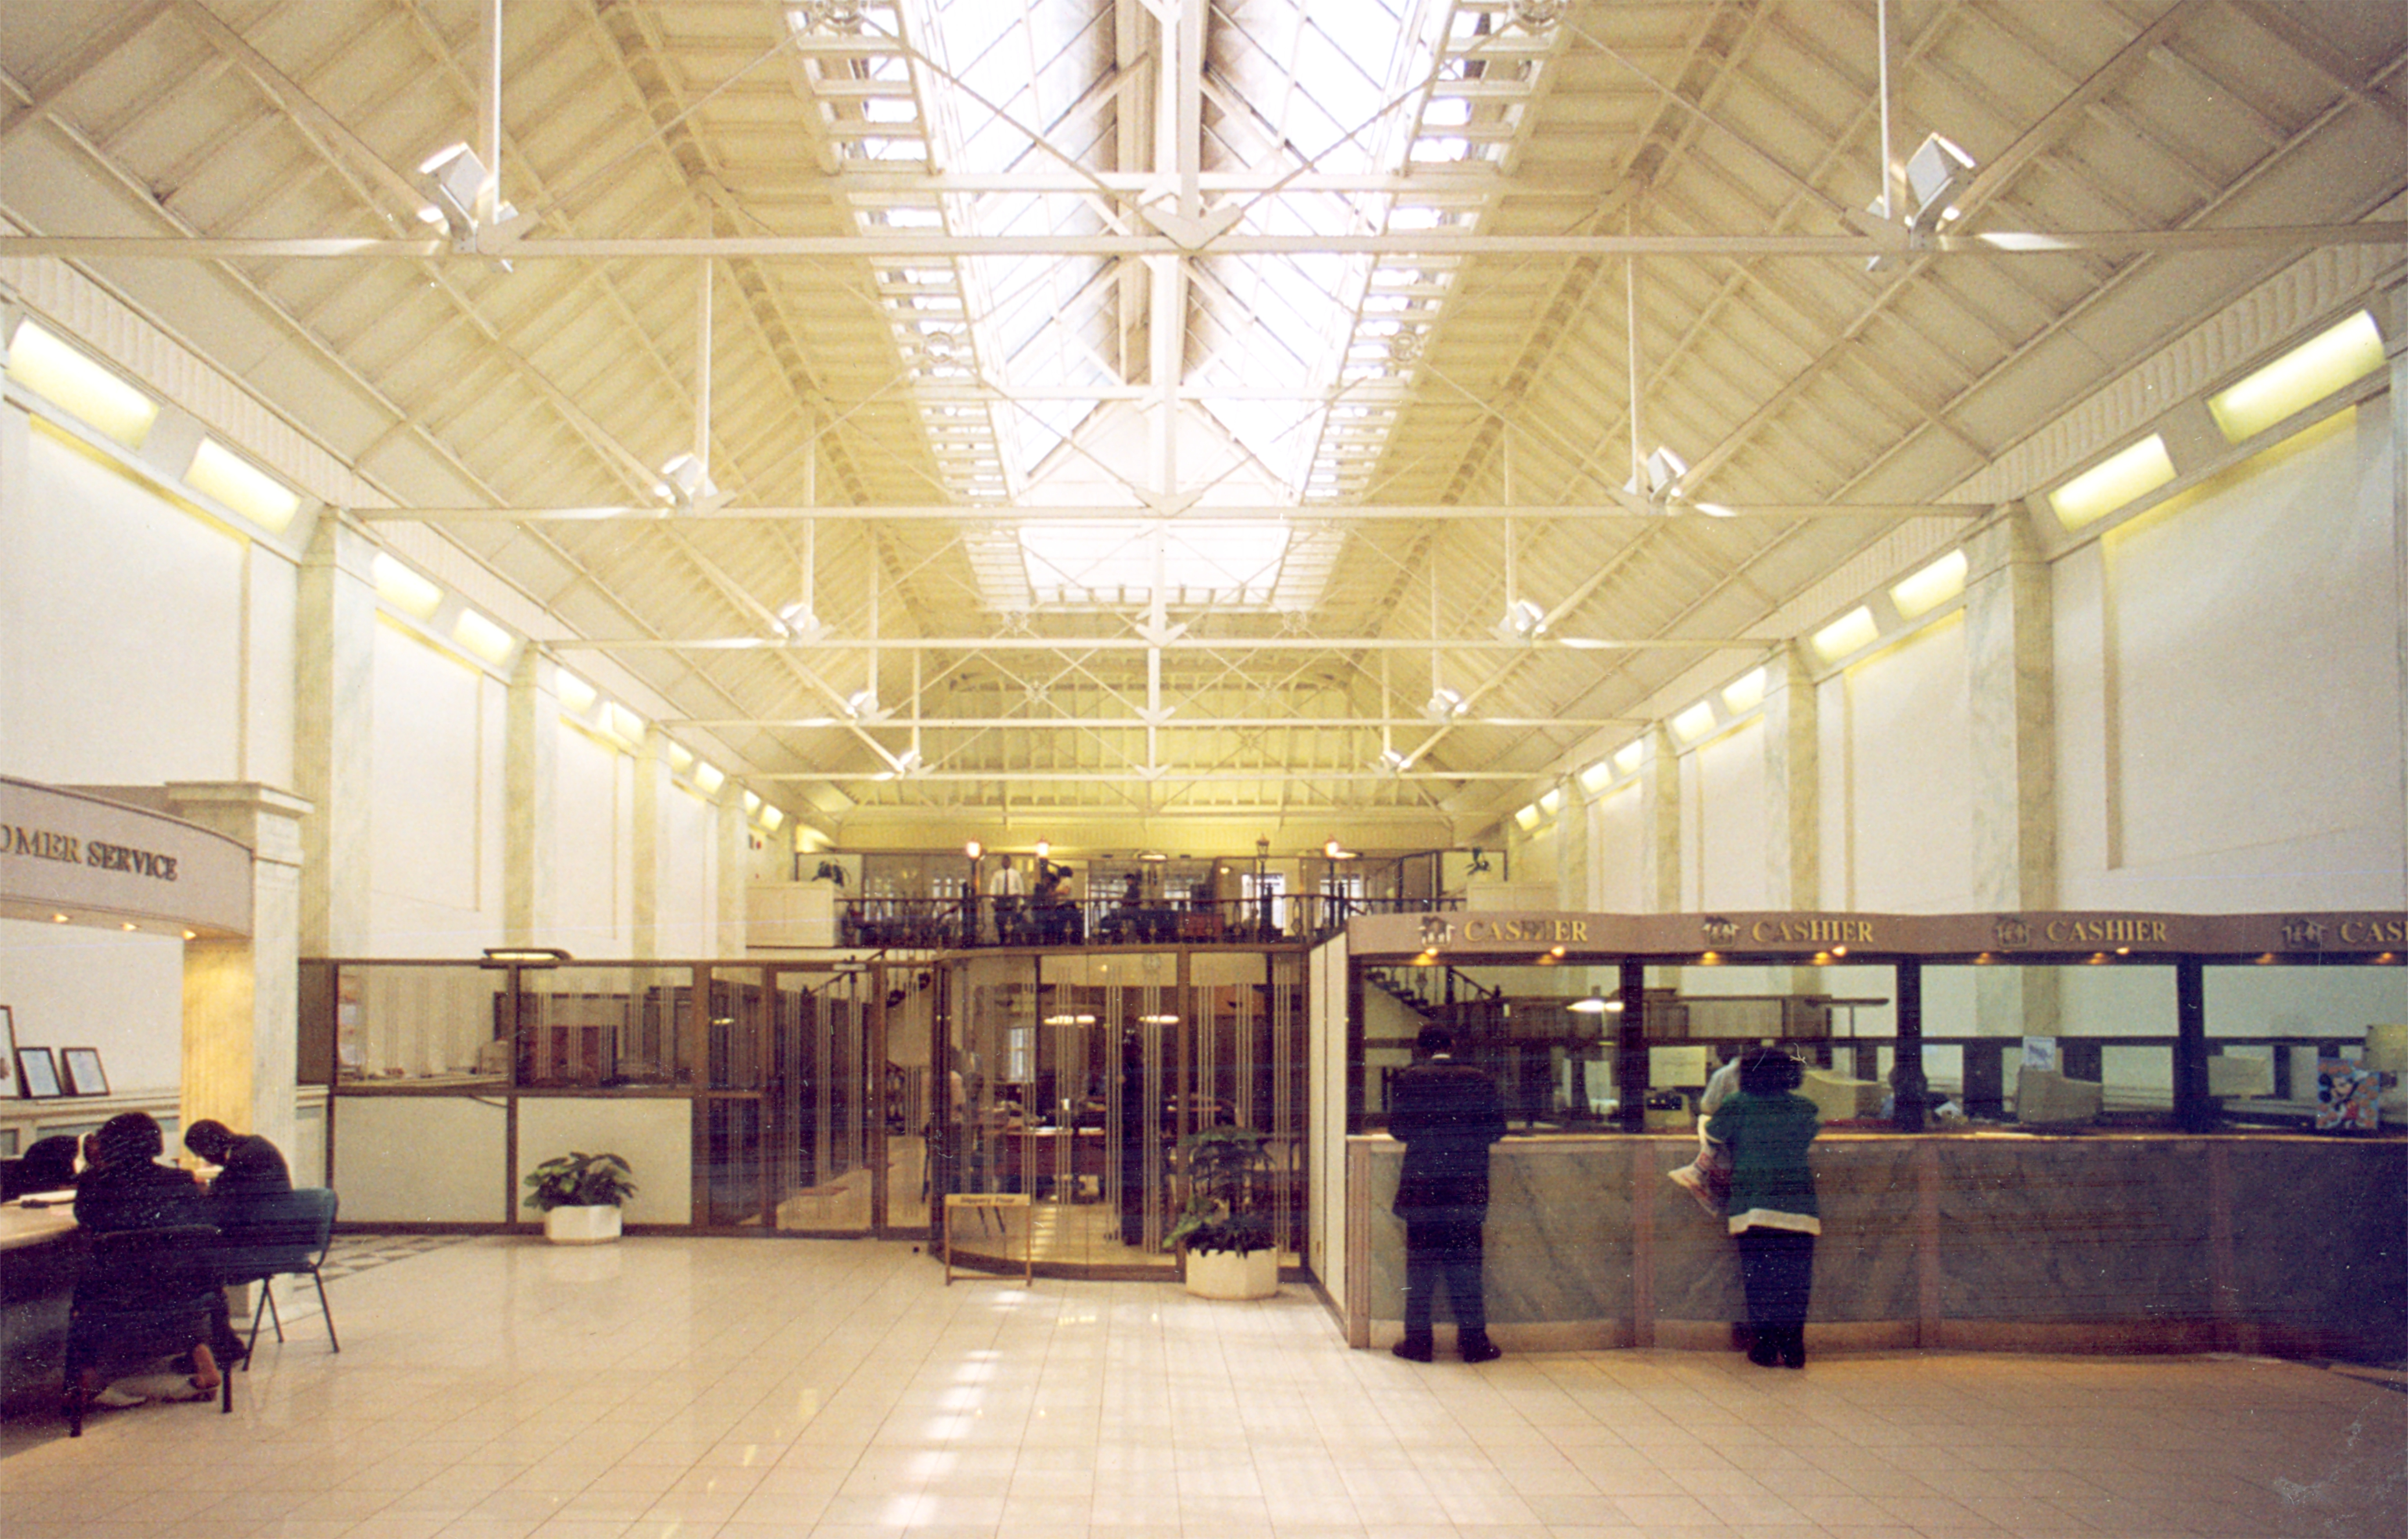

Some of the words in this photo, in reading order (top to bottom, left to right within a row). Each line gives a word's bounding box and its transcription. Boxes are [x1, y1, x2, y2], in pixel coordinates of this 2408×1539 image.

[87, 840, 178, 882] SERVICE
[1464, 919, 1588, 942] CASHIER
[1752, 919, 1874, 942] CASHIER
[2046, 919, 2167, 942] CASHIER
[2340, 920, 2407, 943] CAS
